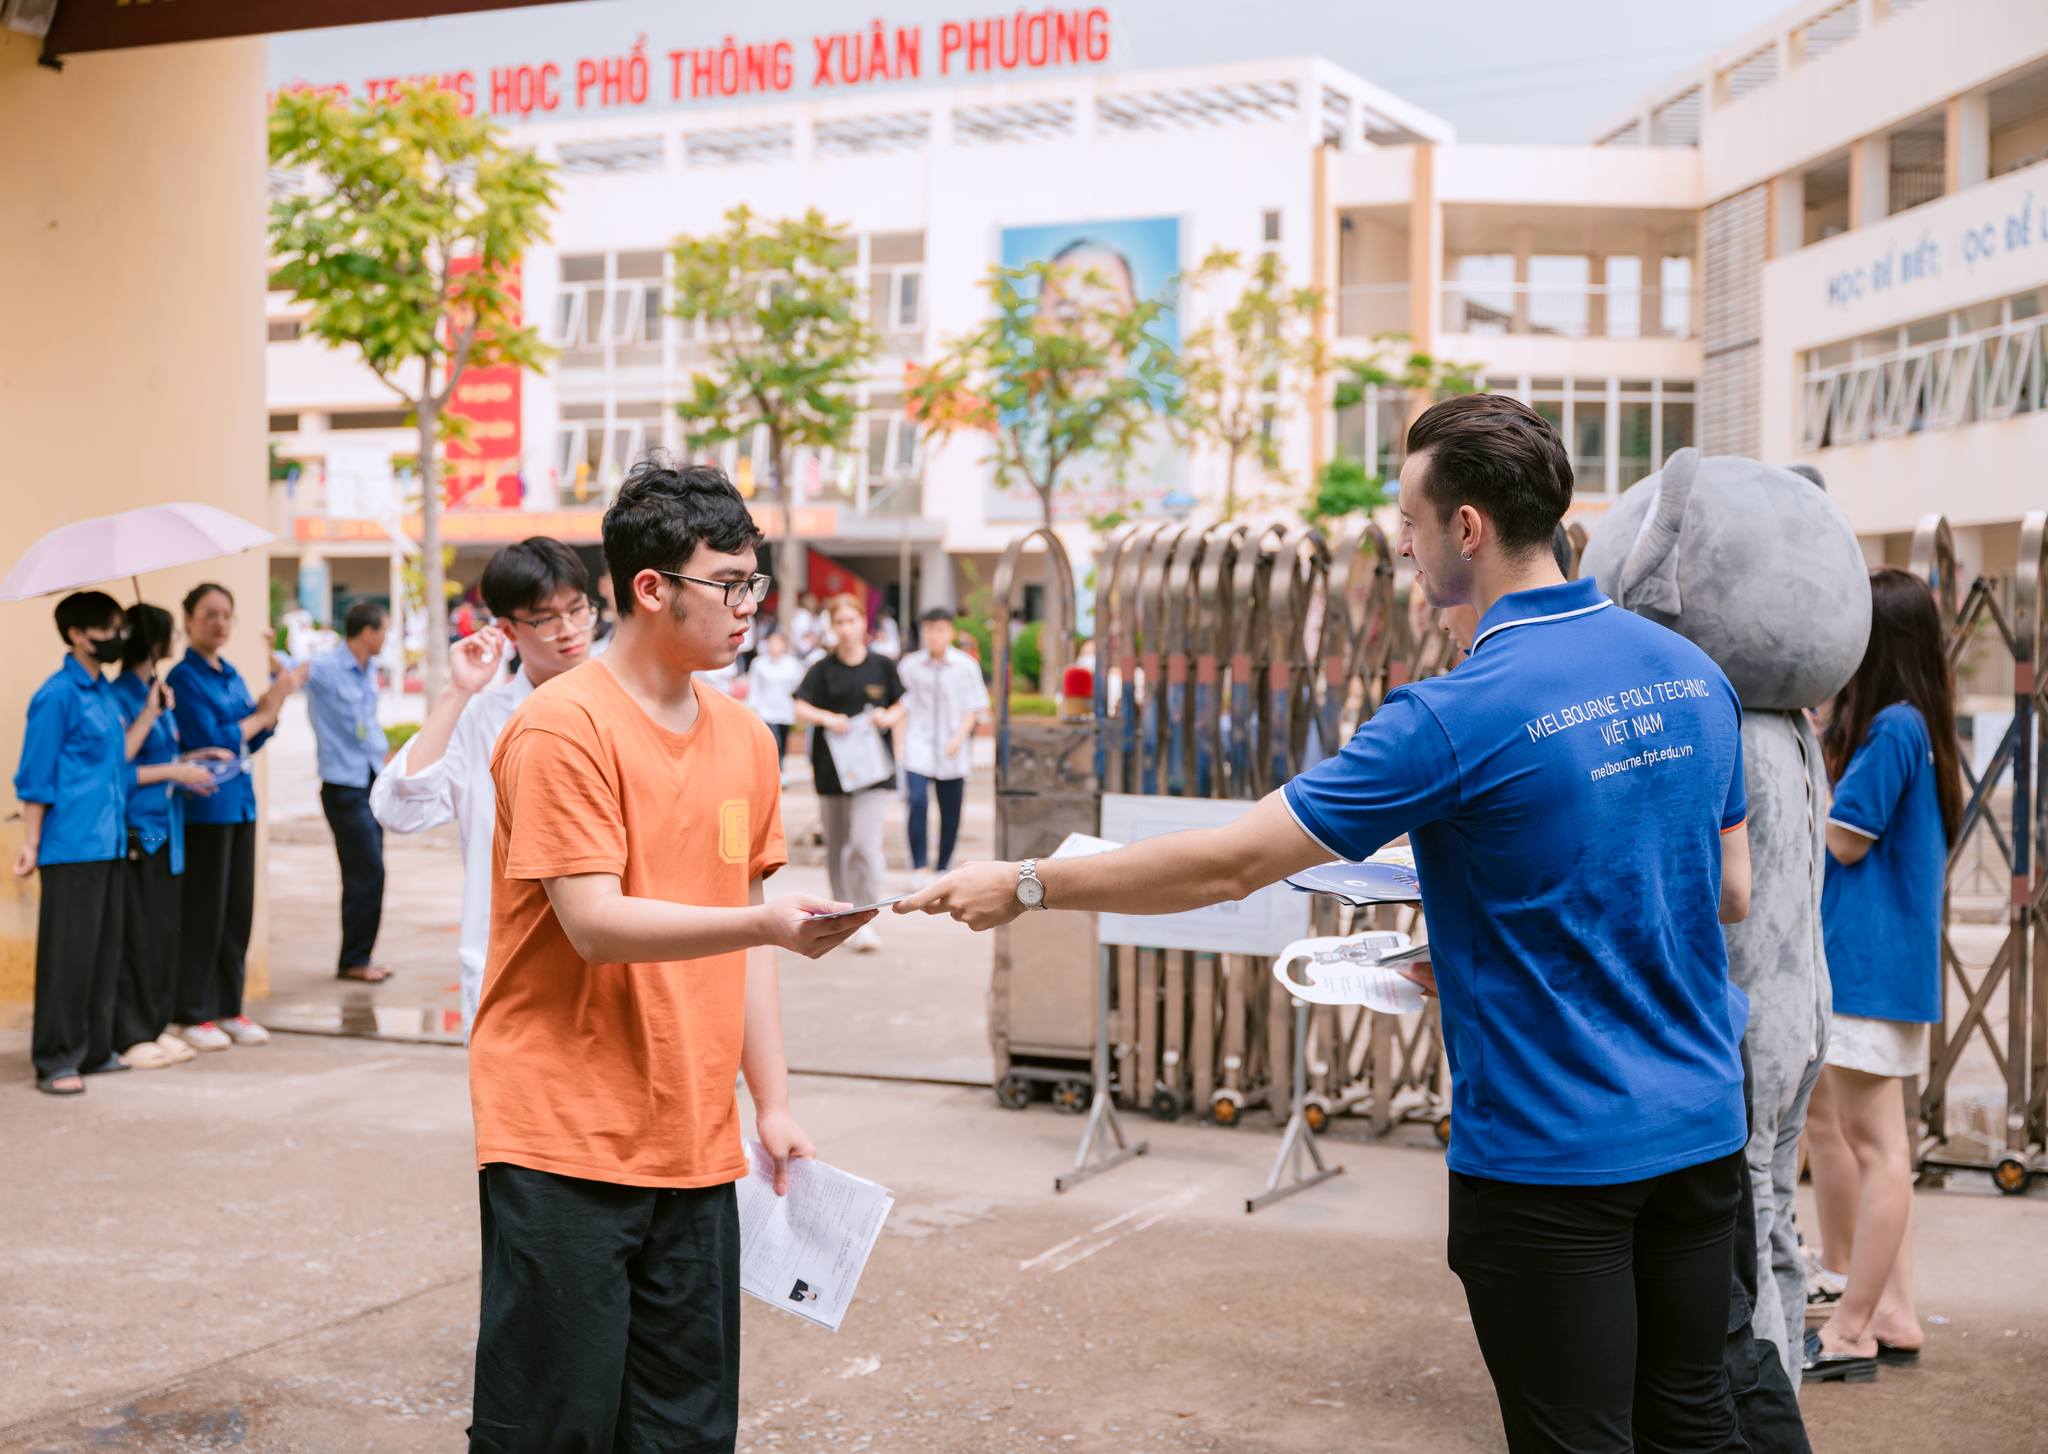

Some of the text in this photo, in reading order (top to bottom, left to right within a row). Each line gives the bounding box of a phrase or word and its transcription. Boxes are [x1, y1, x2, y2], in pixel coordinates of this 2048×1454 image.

[490, 62, 560, 121] HỌC
[576, 34, 650, 108] PHỔ
[668, 34, 794, 101] THÔNG
[812, 17, 921, 88] XUÂN
[939, 7, 1110, 76] PHƯƠNG
[1526, 696, 1619, 743] MELBOURNE
[1600, 712, 1664, 746] VIỆT NAM
[1590, 744, 1693, 782] melbourne.fpt.edu.vn
